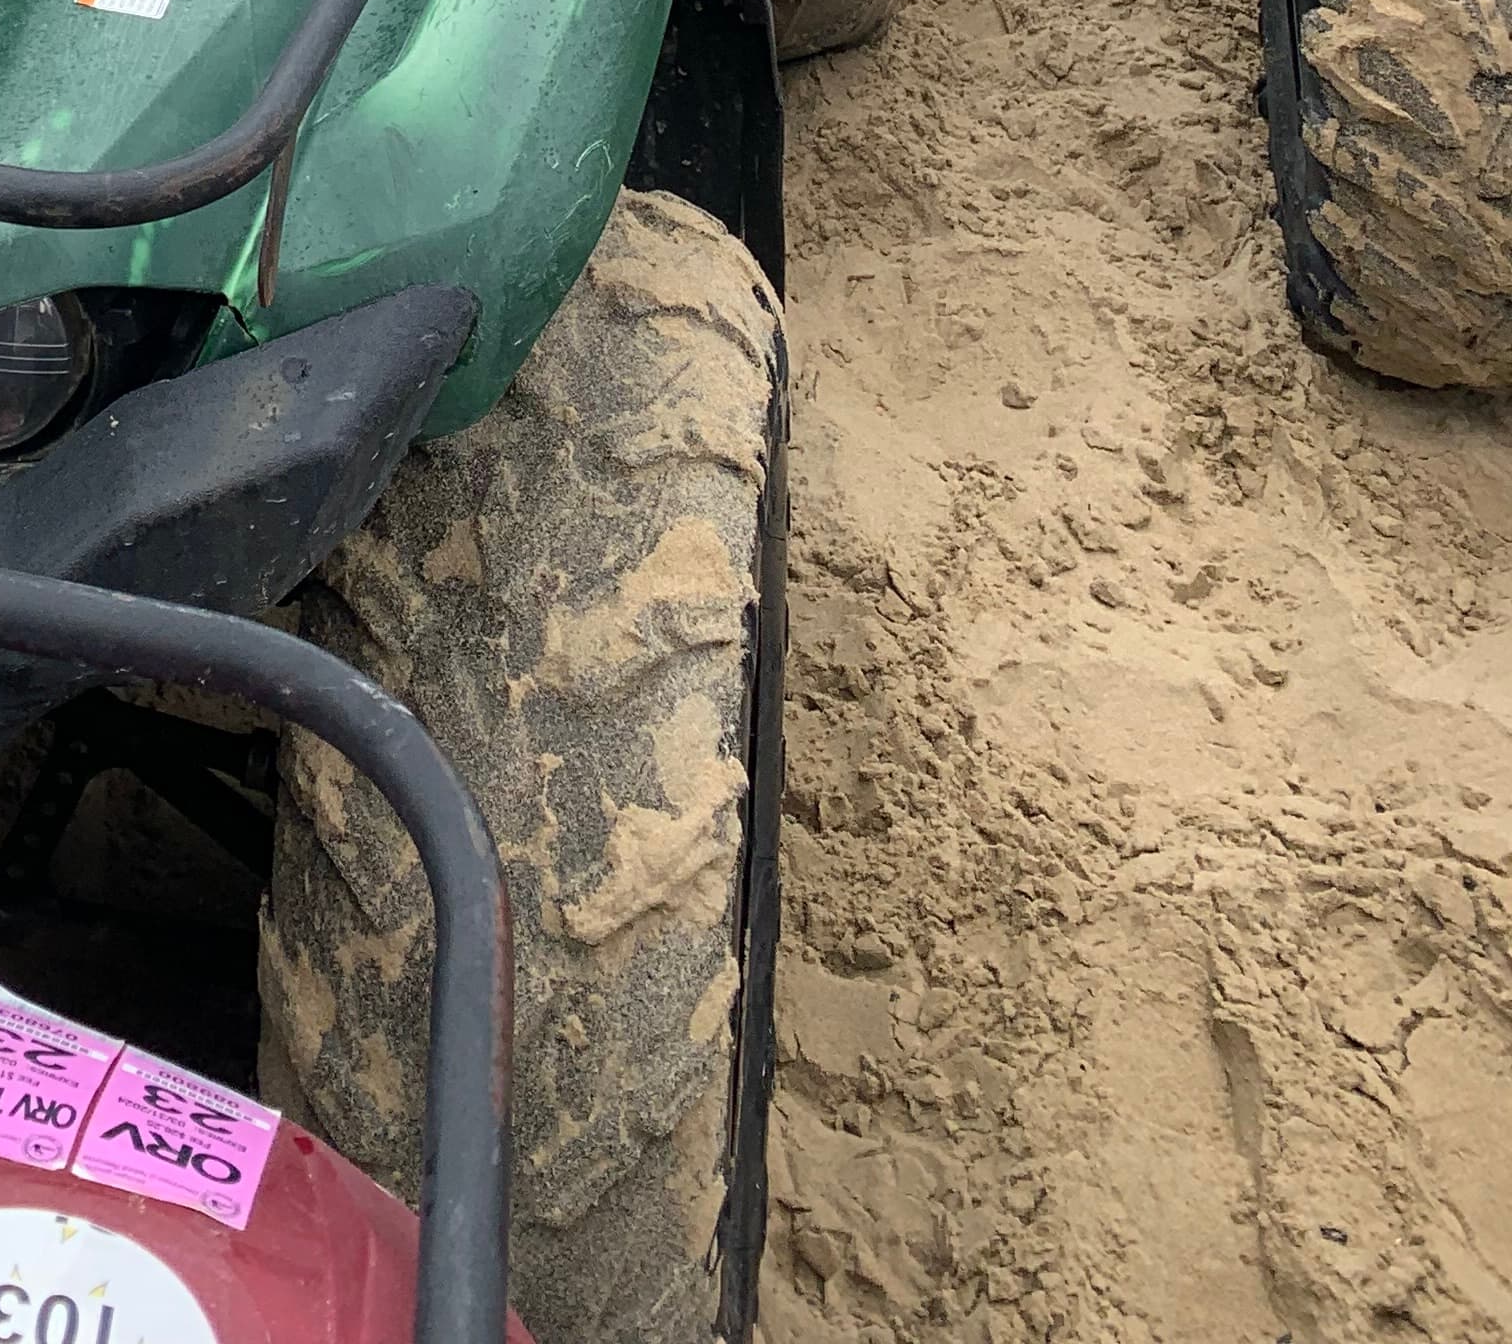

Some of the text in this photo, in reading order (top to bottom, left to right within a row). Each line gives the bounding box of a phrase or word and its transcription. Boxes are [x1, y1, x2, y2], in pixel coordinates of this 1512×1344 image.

[8, 1094, 78, 1129] ORV
[143, 1084, 239, 1135] 23
[98, 1120, 241, 1184] ORV
